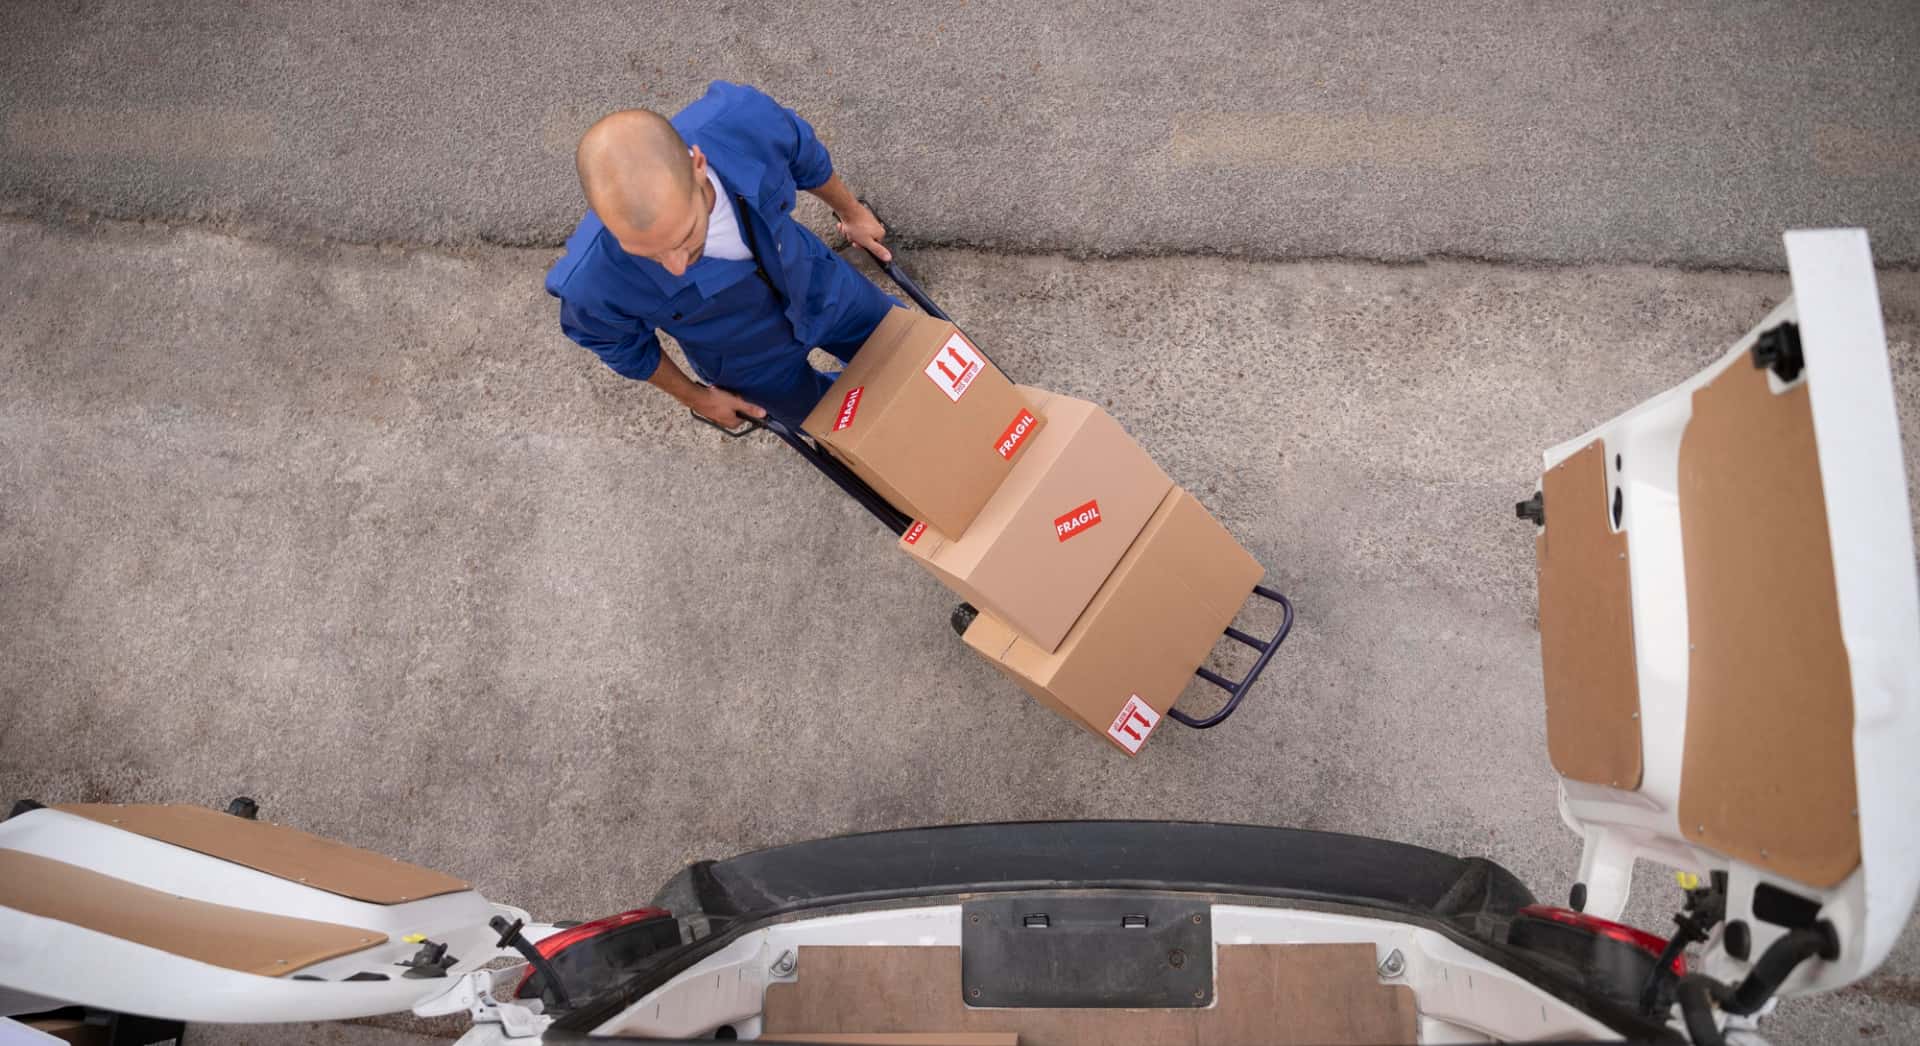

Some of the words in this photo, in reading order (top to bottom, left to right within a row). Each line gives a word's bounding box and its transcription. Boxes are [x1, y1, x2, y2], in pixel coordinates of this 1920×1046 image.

[838, 388, 860, 430] FRAGIL
[998, 415, 1034, 457] FRAGIL
[906, 523, 924, 541] GIL
[1057, 507, 1099, 536] FRAGIL
